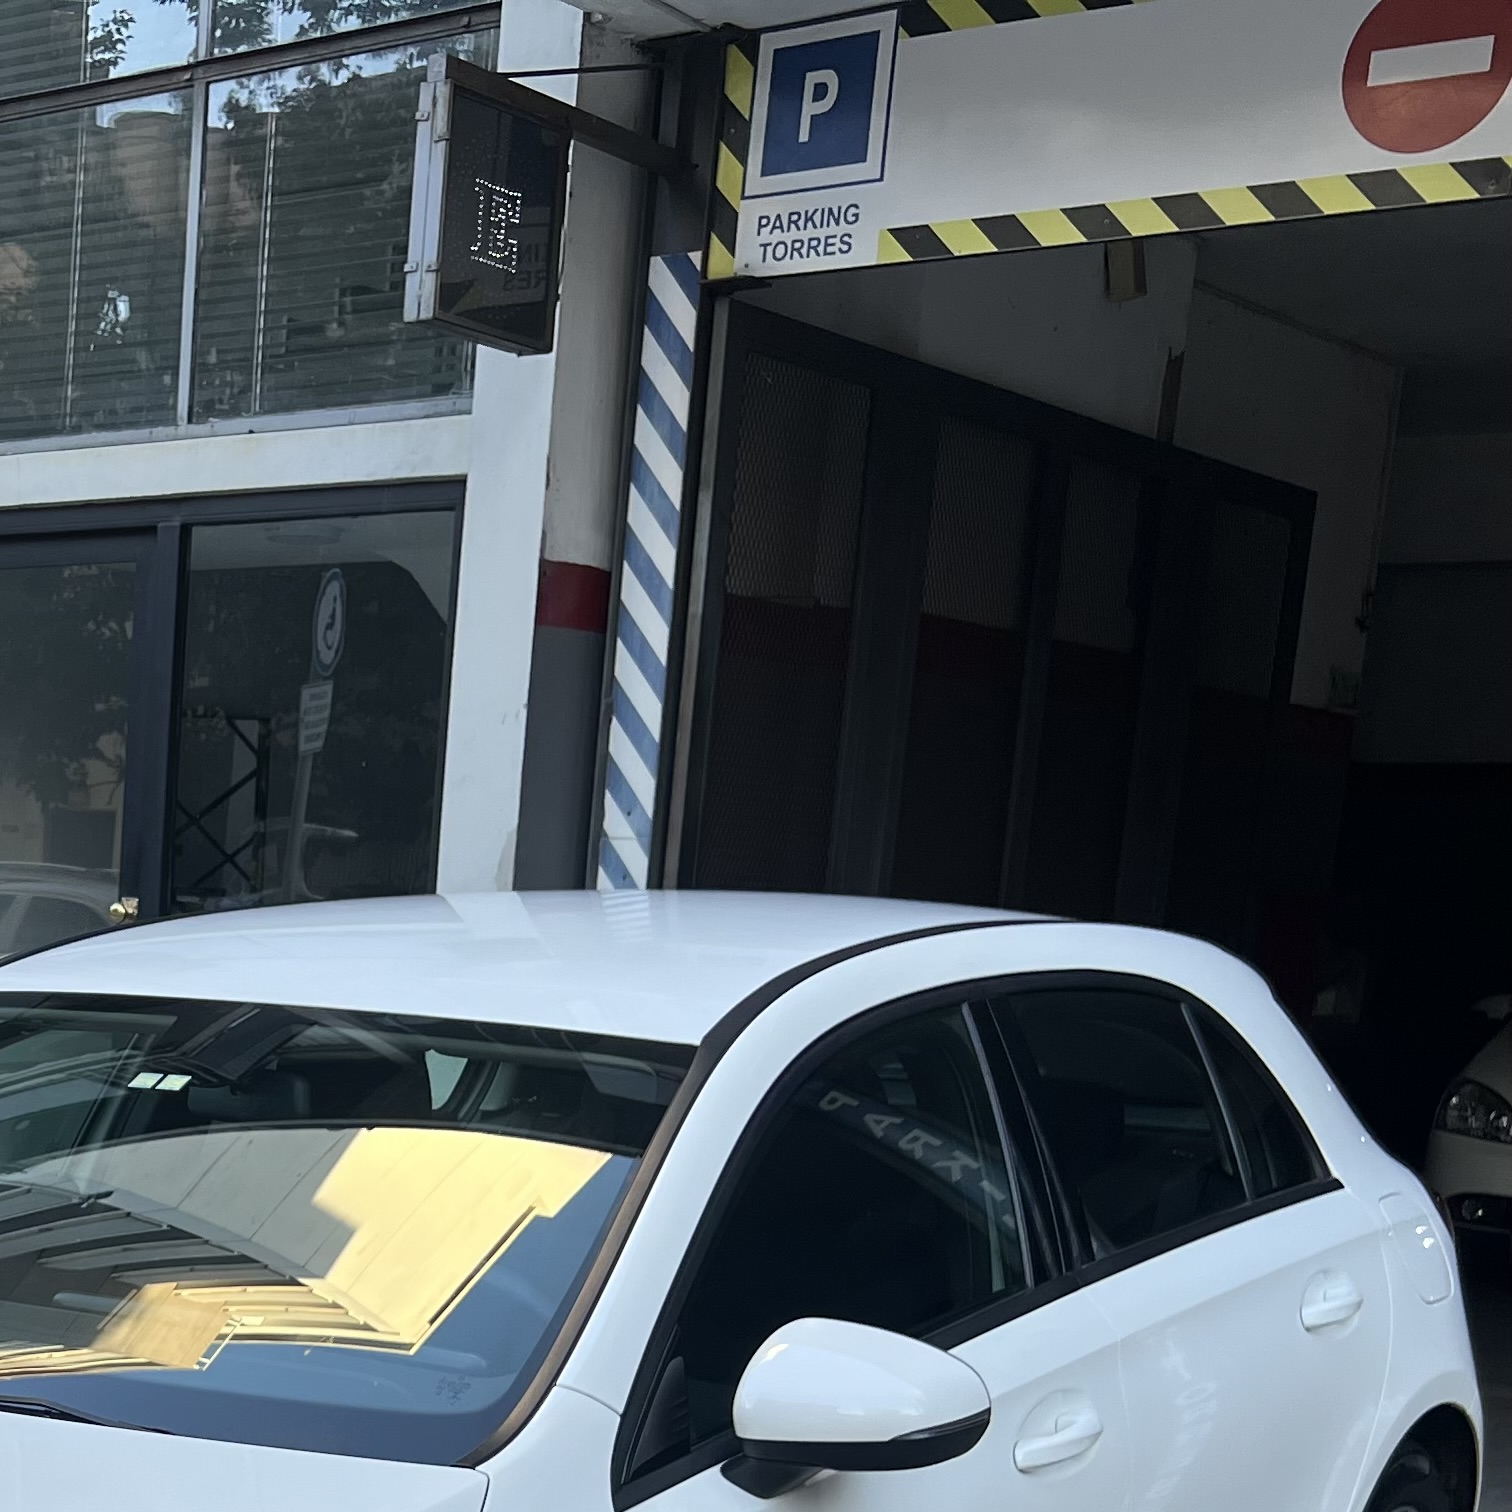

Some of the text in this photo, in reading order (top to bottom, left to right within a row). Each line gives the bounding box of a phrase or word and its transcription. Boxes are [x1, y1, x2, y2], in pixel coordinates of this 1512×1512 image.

[797, 68, 839, 143] P
[756, 203, 861, 237] PARKING
[759, 233, 853, 264] TORRES
